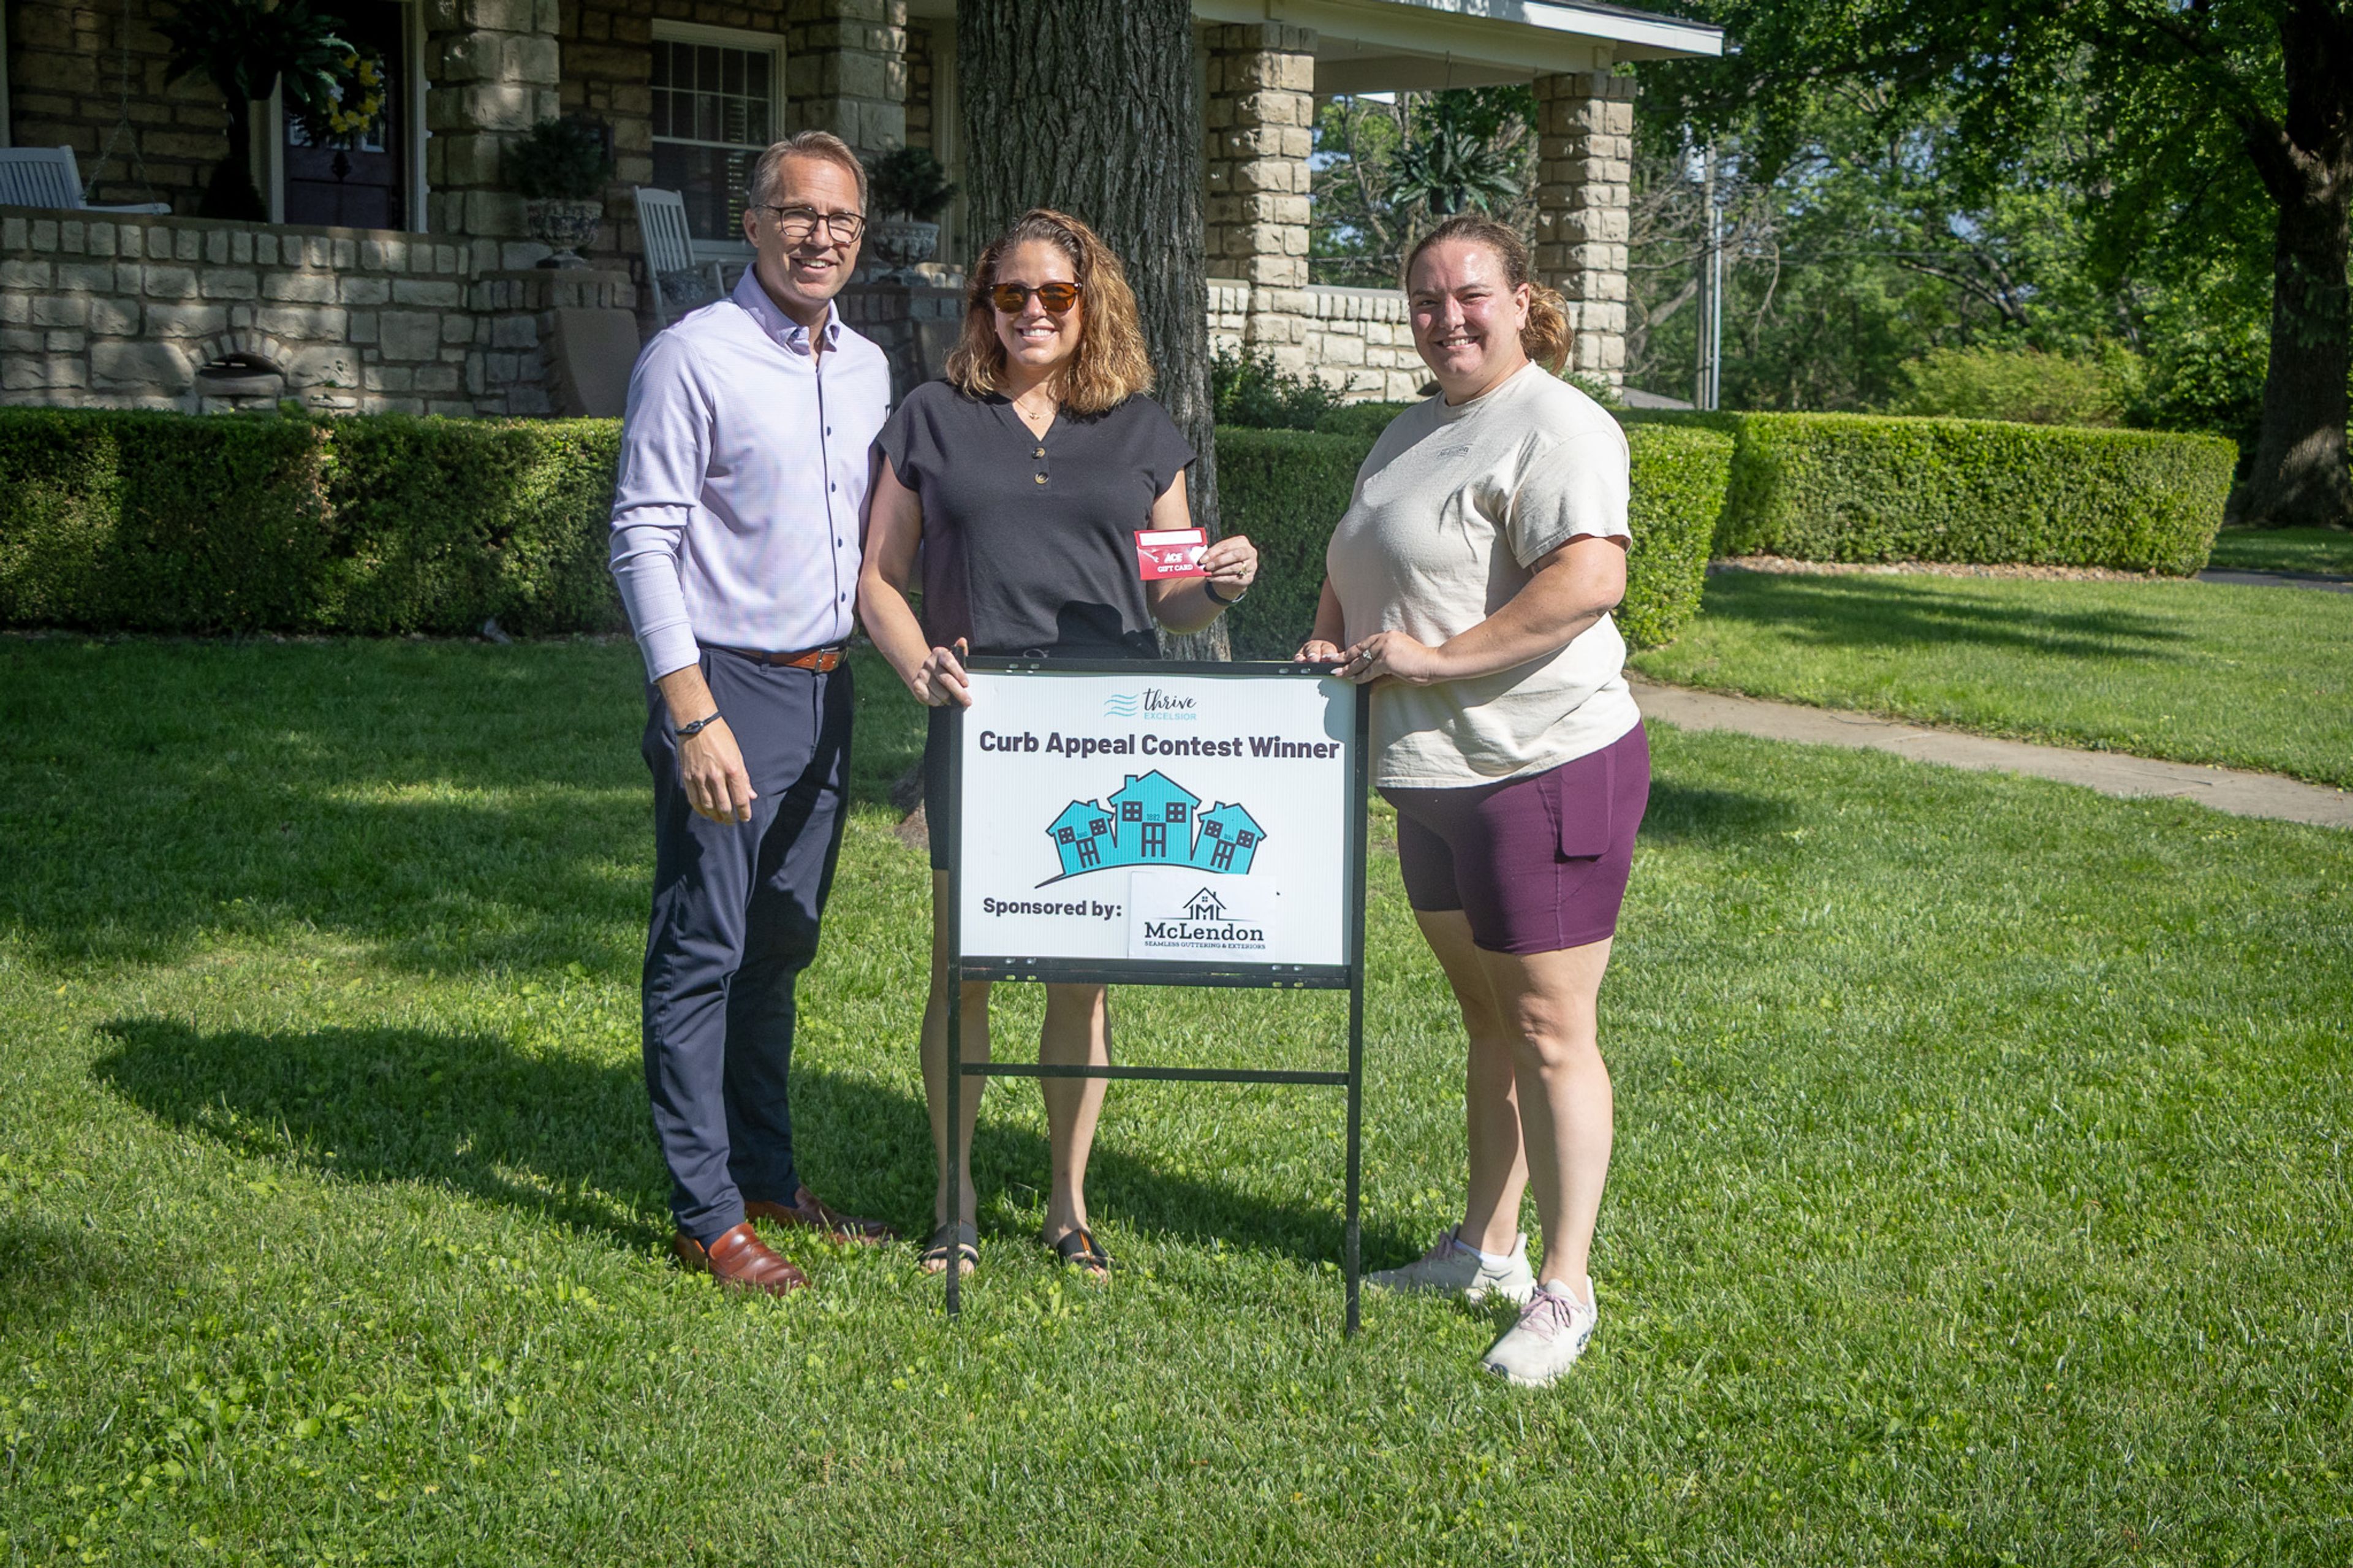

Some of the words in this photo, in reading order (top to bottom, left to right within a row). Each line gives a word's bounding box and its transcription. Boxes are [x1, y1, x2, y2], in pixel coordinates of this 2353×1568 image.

[1164, 553, 1183, 562] ACE
[1142, 687, 1197, 711] thrive
[1144, 712, 1197, 721] EXCELSIOR
[979, 730, 1039, 752] Curb
[1045, 732, 1135, 759] Appeal
[1142, 734, 1243, 757] Contest
[1248, 735, 1340, 759] Winner
[983, 897, 1087, 917] Sponsored
[1091, 900, 1123, 921] by:
[1144, 921, 1264, 941] McLendon
